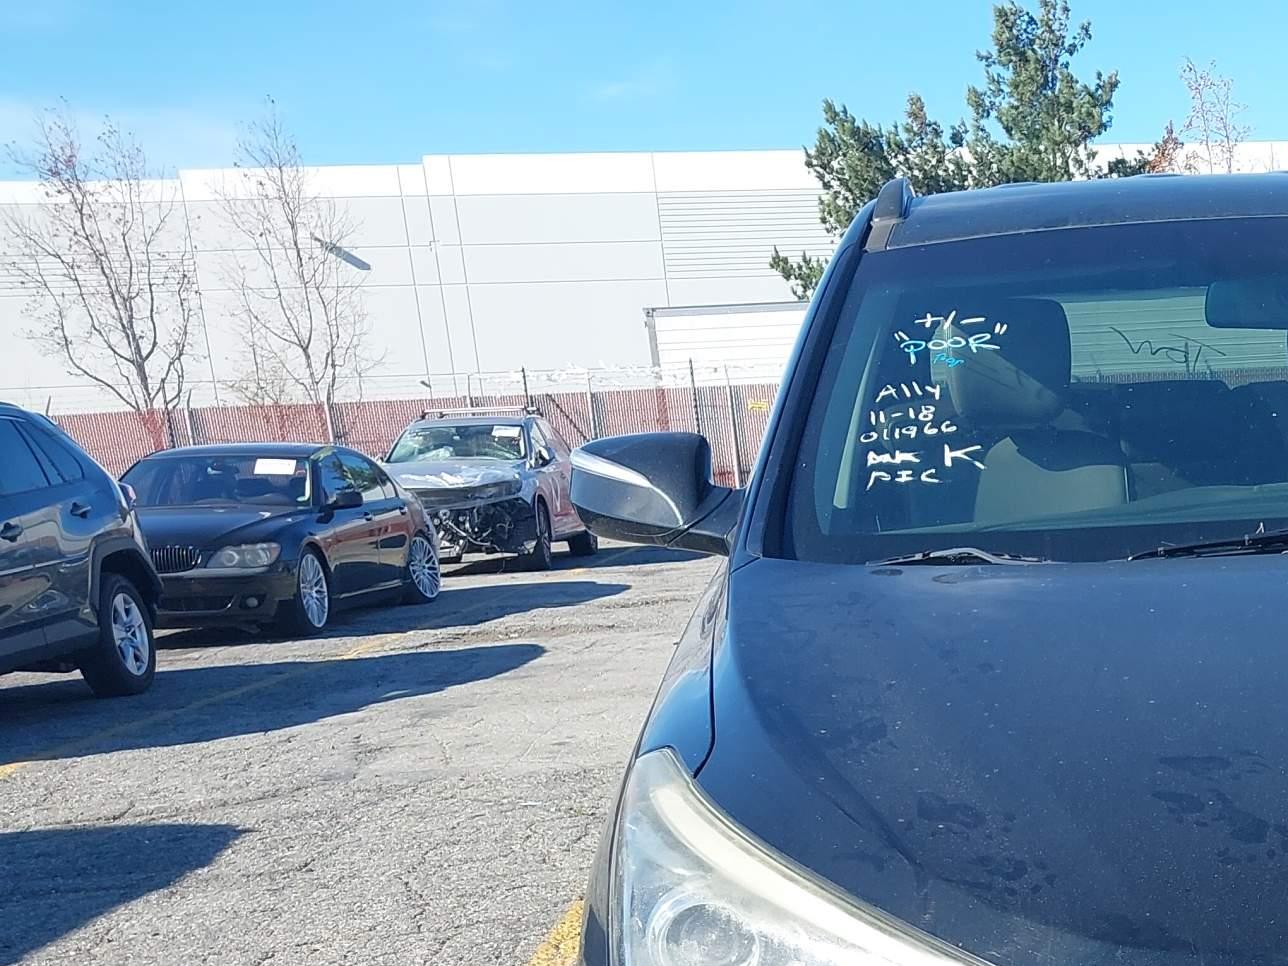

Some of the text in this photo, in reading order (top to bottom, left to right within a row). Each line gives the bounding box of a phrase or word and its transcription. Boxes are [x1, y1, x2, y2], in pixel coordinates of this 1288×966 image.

[870, 405, 936, 426] 11-18
[860, 420, 958, 443] 011966
[943, 443, 988, 470] K
